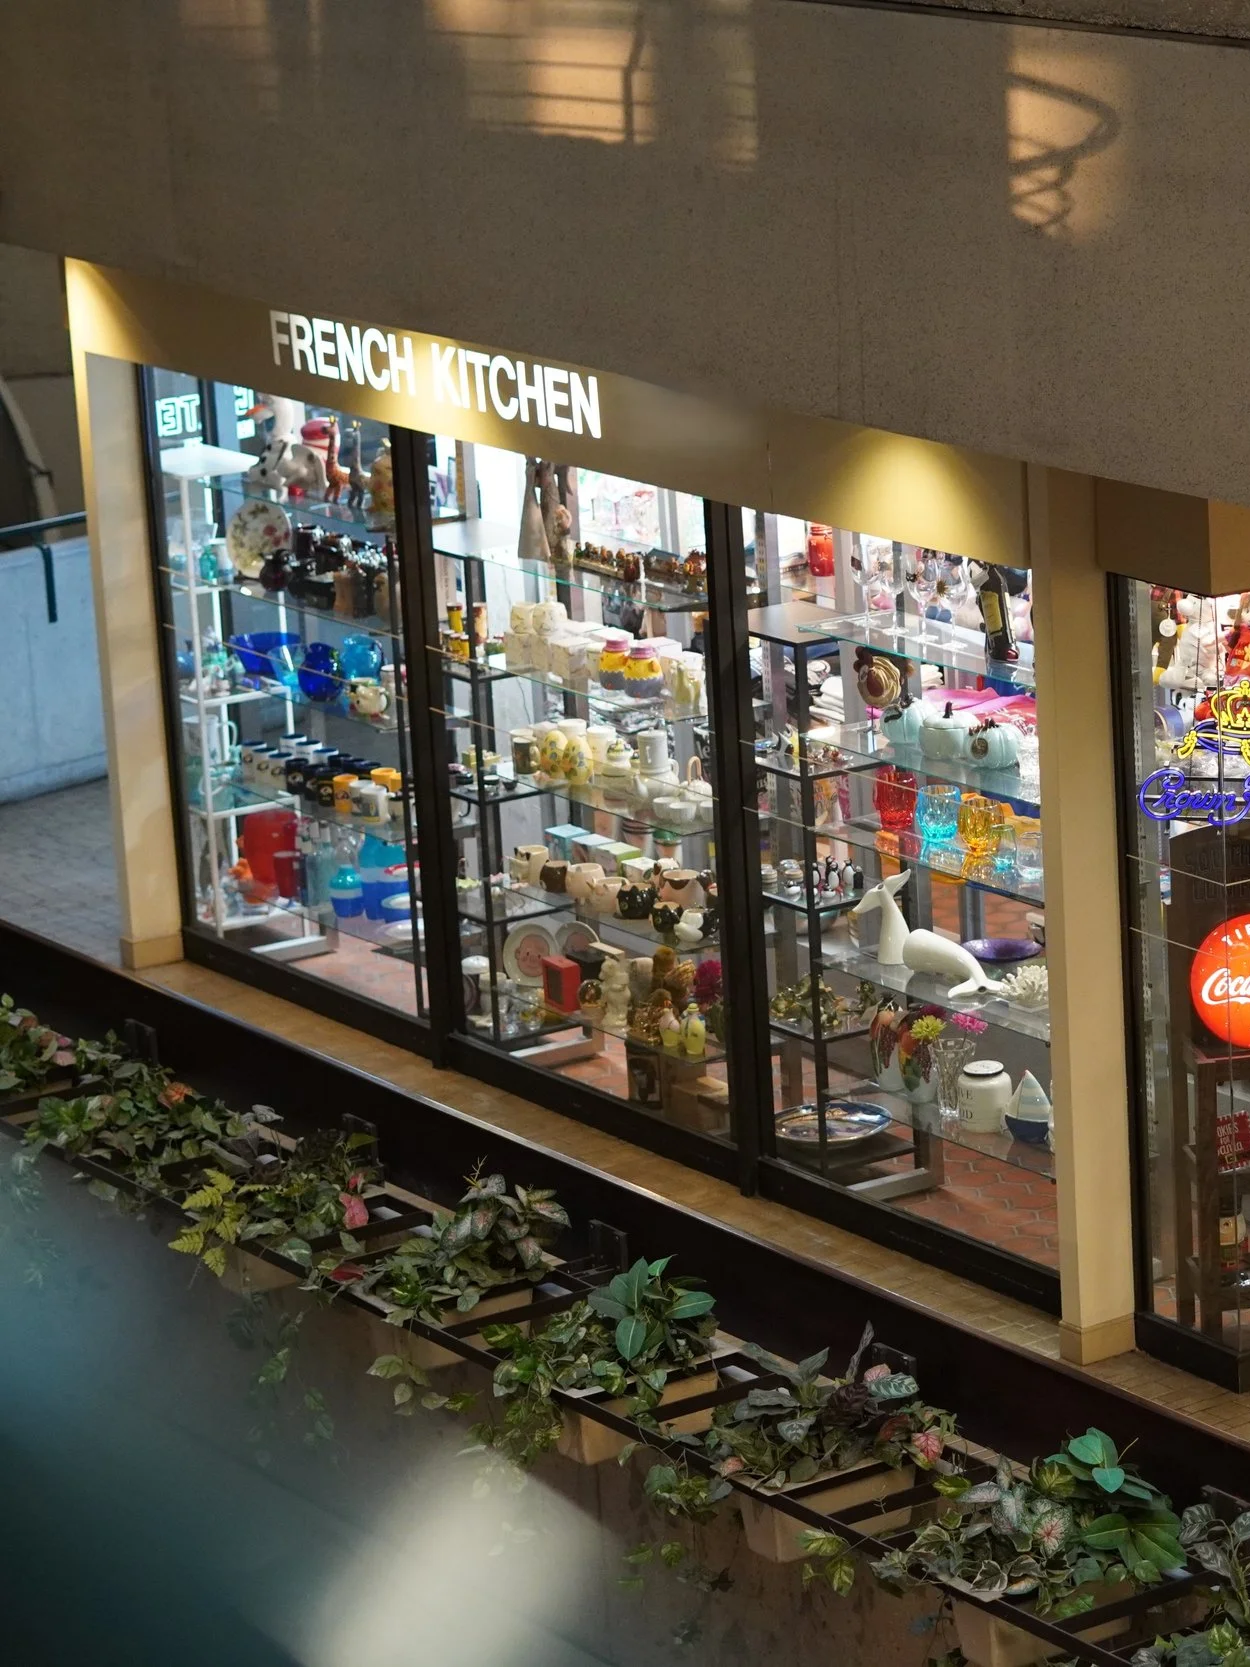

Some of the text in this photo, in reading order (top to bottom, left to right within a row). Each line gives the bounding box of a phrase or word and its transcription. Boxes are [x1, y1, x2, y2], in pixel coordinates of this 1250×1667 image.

[269, 309, 602, 439] FRENCH KITCHEN
[1138, 768, 1237, 821] Crown
